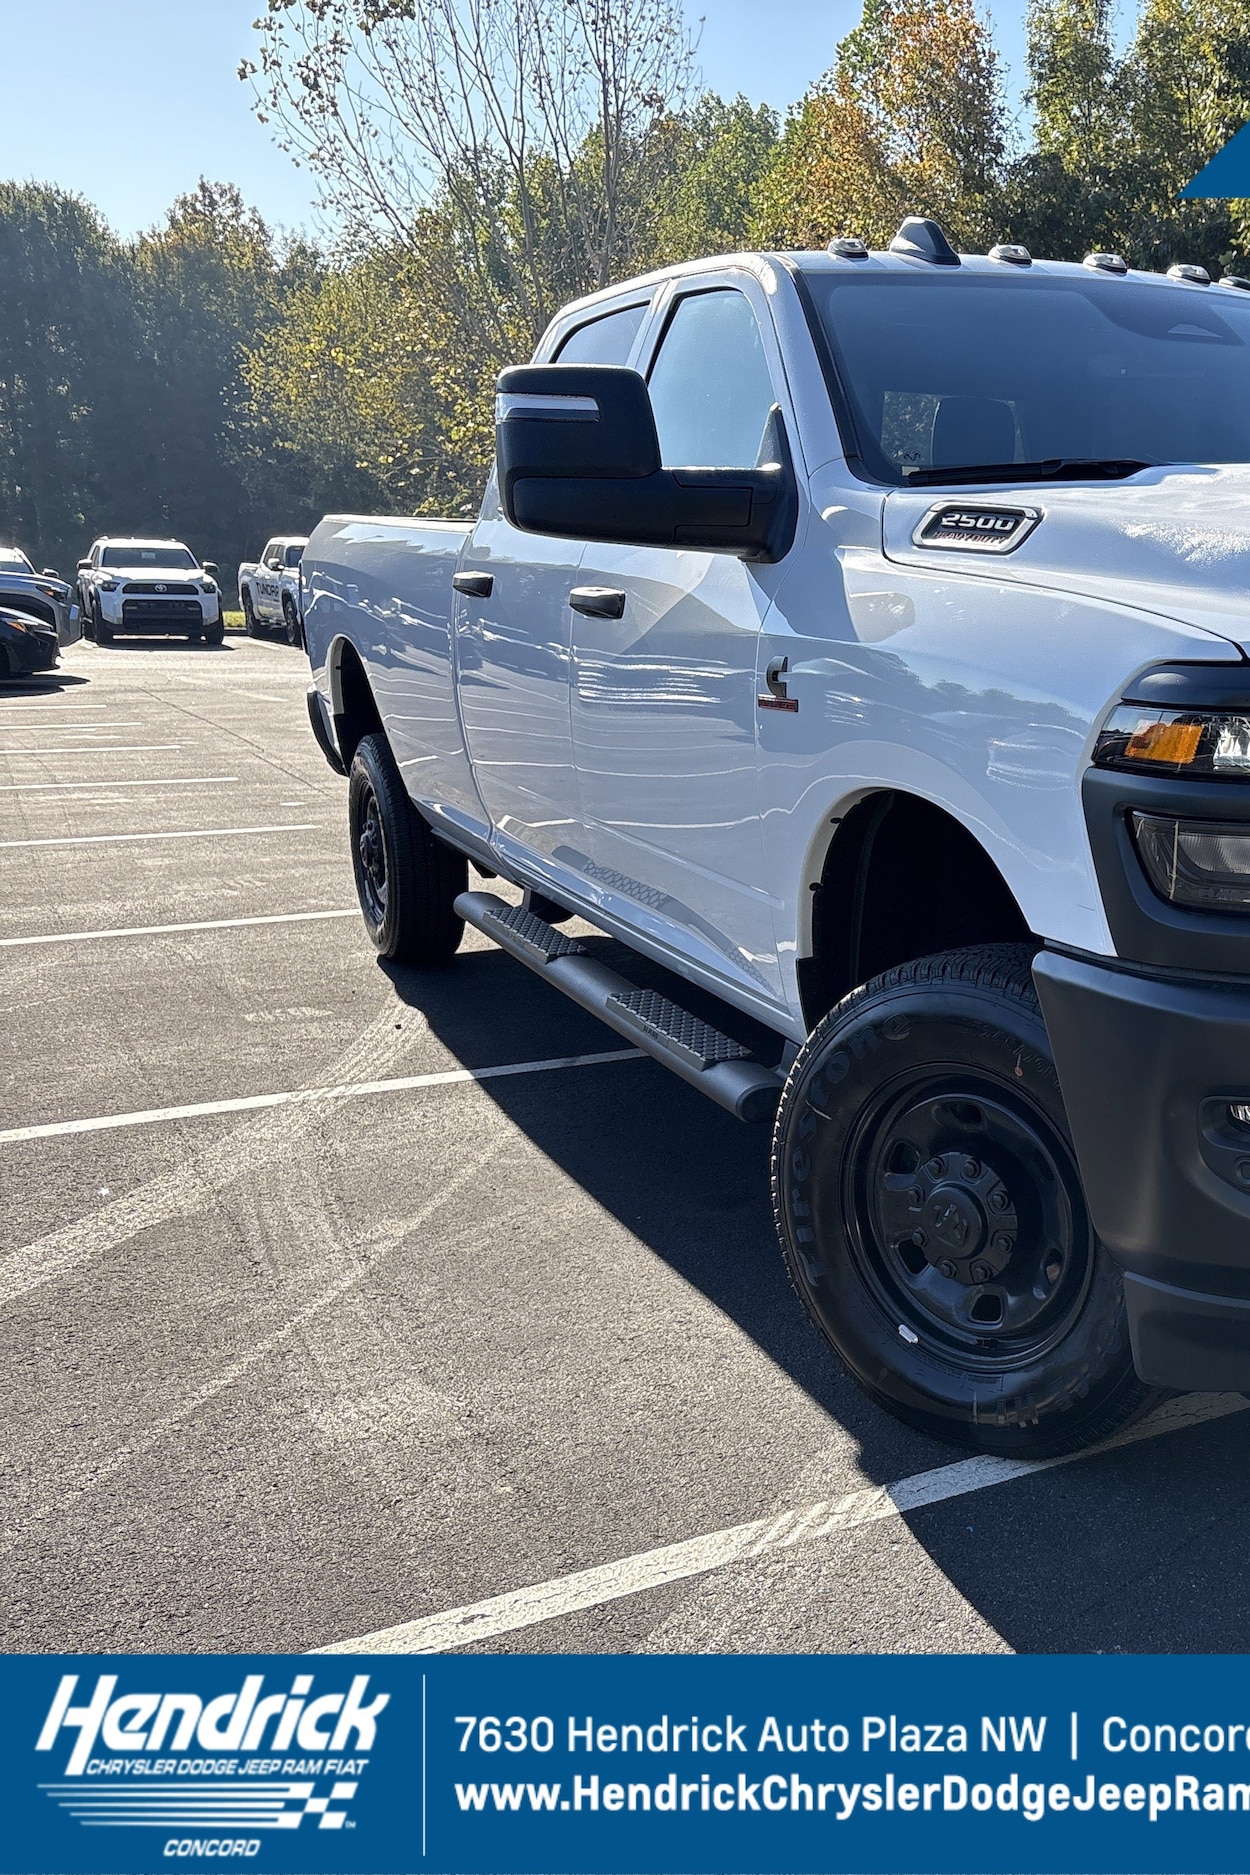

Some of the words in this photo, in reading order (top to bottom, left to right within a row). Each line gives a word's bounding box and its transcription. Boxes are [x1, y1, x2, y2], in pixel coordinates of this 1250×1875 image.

[941, 513, 1015, 531] 2500
[933, 531, 971, 543] HEAVY
[971, 534, 1007, 544] DUTY
